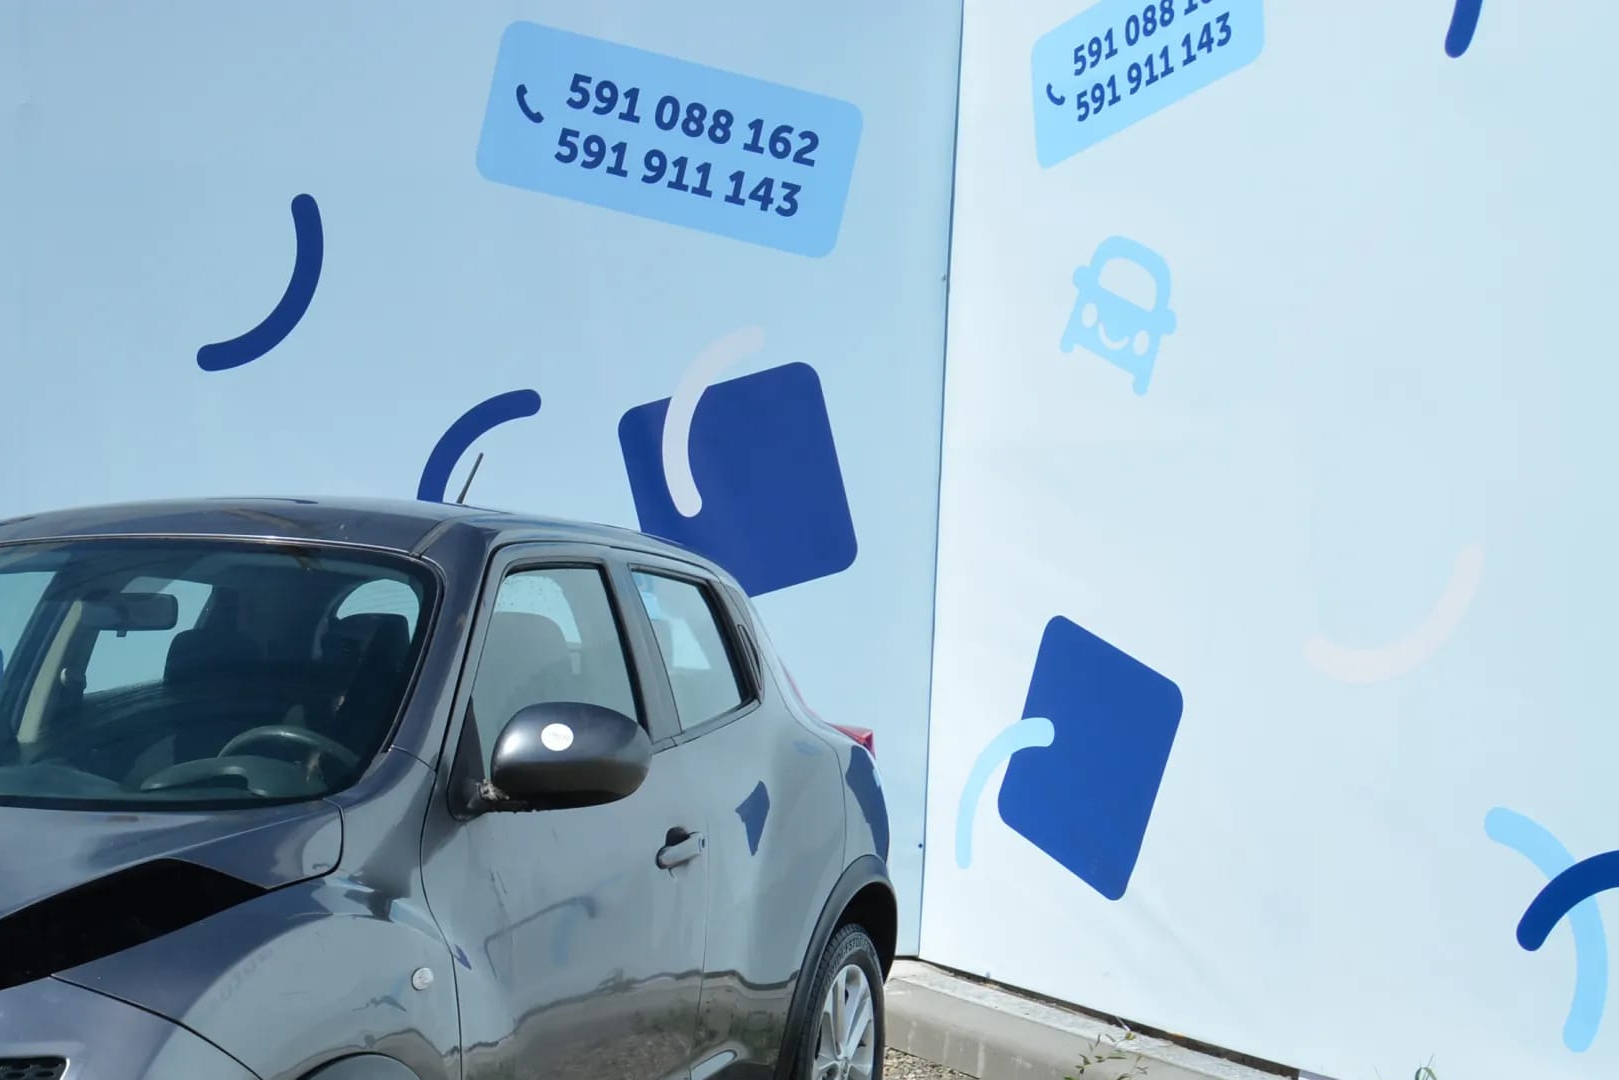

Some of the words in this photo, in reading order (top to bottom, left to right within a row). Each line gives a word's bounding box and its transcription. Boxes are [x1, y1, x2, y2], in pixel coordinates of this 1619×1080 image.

[1073, 27, 1118, 77] 591
[1124, 0, 1175, 48] 088
[1076, 74, 1122, 122] 591
[1126, 44, 1175, 96] 911
[1181, 12, 1232, 67] 143
[565, 72, 641, 124] 591
[654, 95, 735, 145] 088
[742, 118, 820, 168] 162
[554, 127, 629, 178] 591
[640, 148, 713, 198] 911
[723, 170, 802, 218] 143
